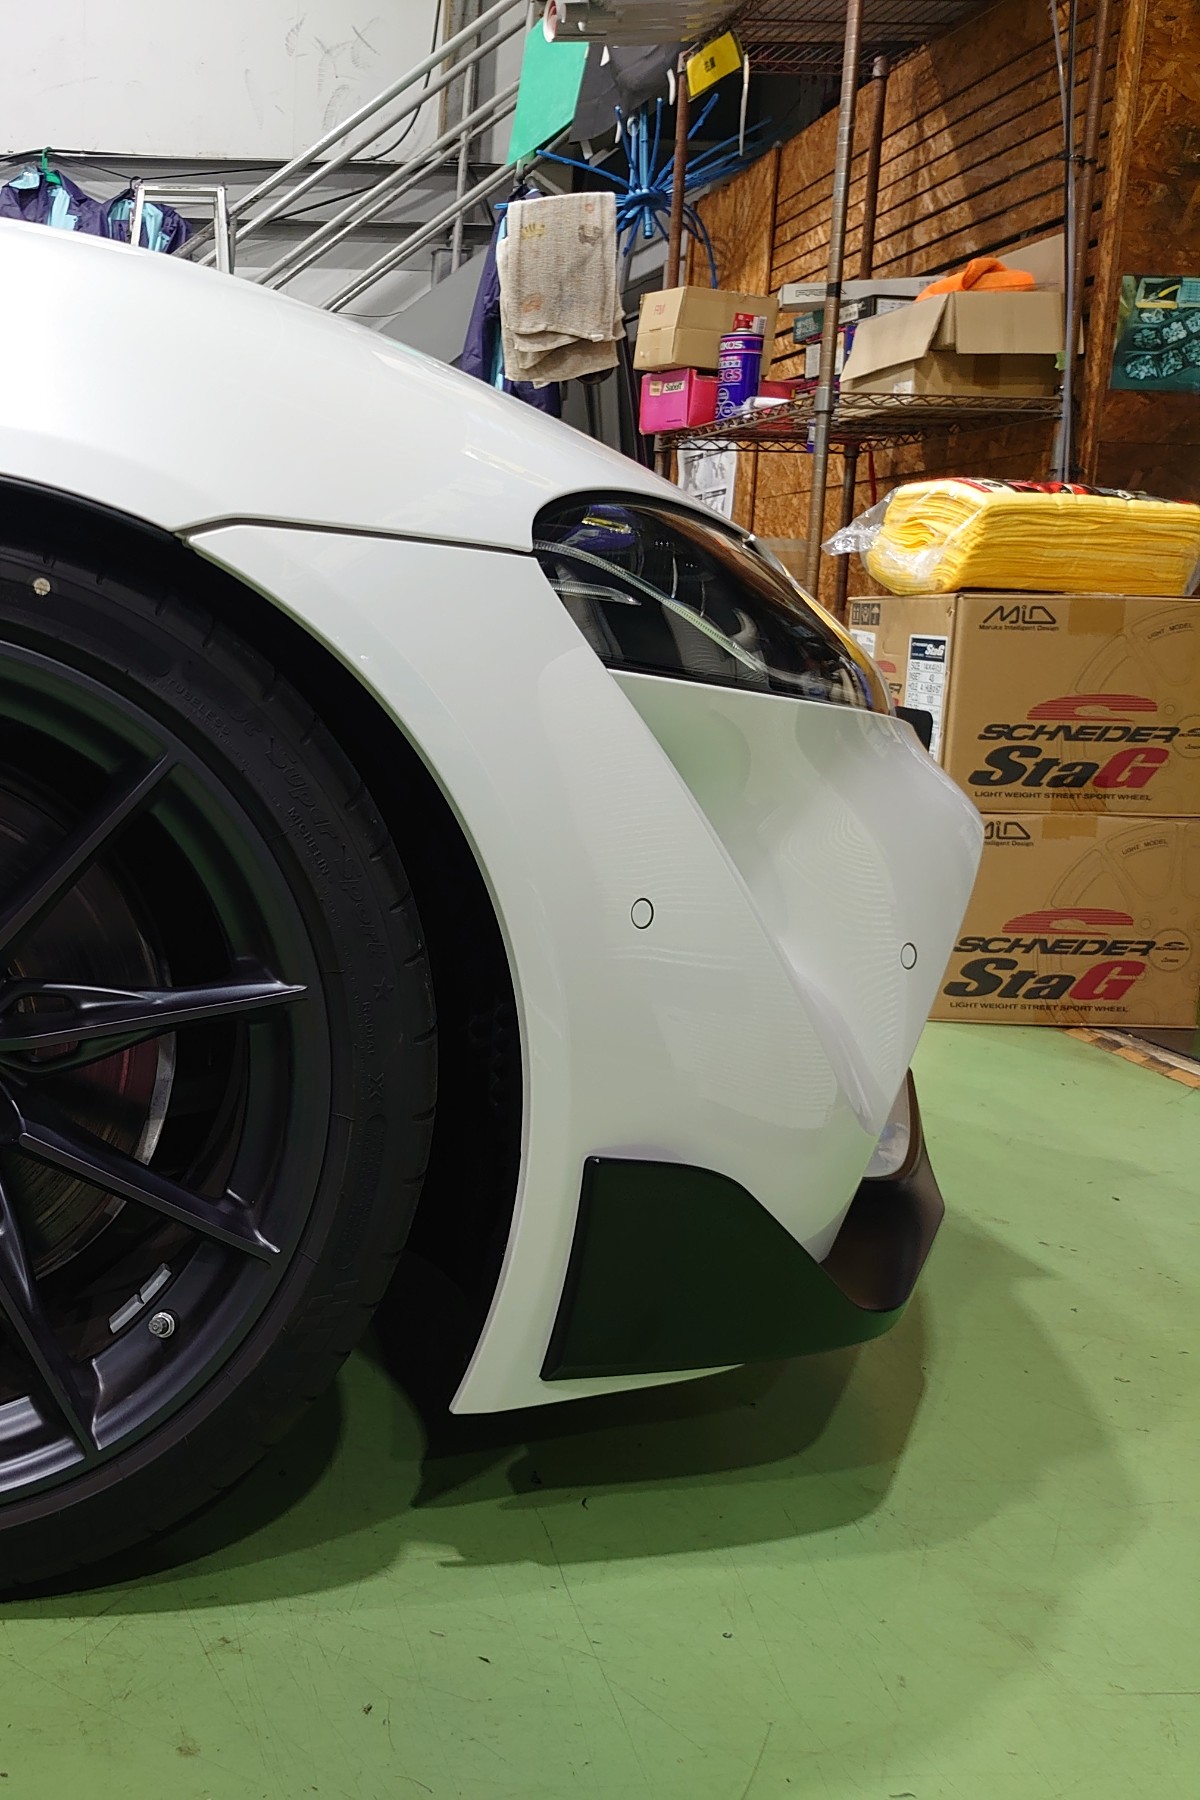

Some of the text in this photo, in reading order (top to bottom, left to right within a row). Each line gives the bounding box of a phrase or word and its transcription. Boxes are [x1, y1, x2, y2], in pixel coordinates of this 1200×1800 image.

[1169, 622, 1193, 633] MODEL
[977, 723, 1180, 744] SCHNEIDER
[968, 745, 1170, 789] StaG
[974, 791, 1003, 799] LIGHT
[1004, 791, 1041, 799] WEIGHT
[1043, 792, 1081, 800] STREET
[1083, 793, 1116, 801] SPORT
[1011, 840, 1034, 848] Design
[1144, 838, 1169, 849] MODEL
[953, 936, 1157, 956] SCHNEIDER
[943, 957, 1147, 1000] StaG
[950, 1002, 1129, 1013] LIGHT WEIGHT STREET SPORT WHEEL
